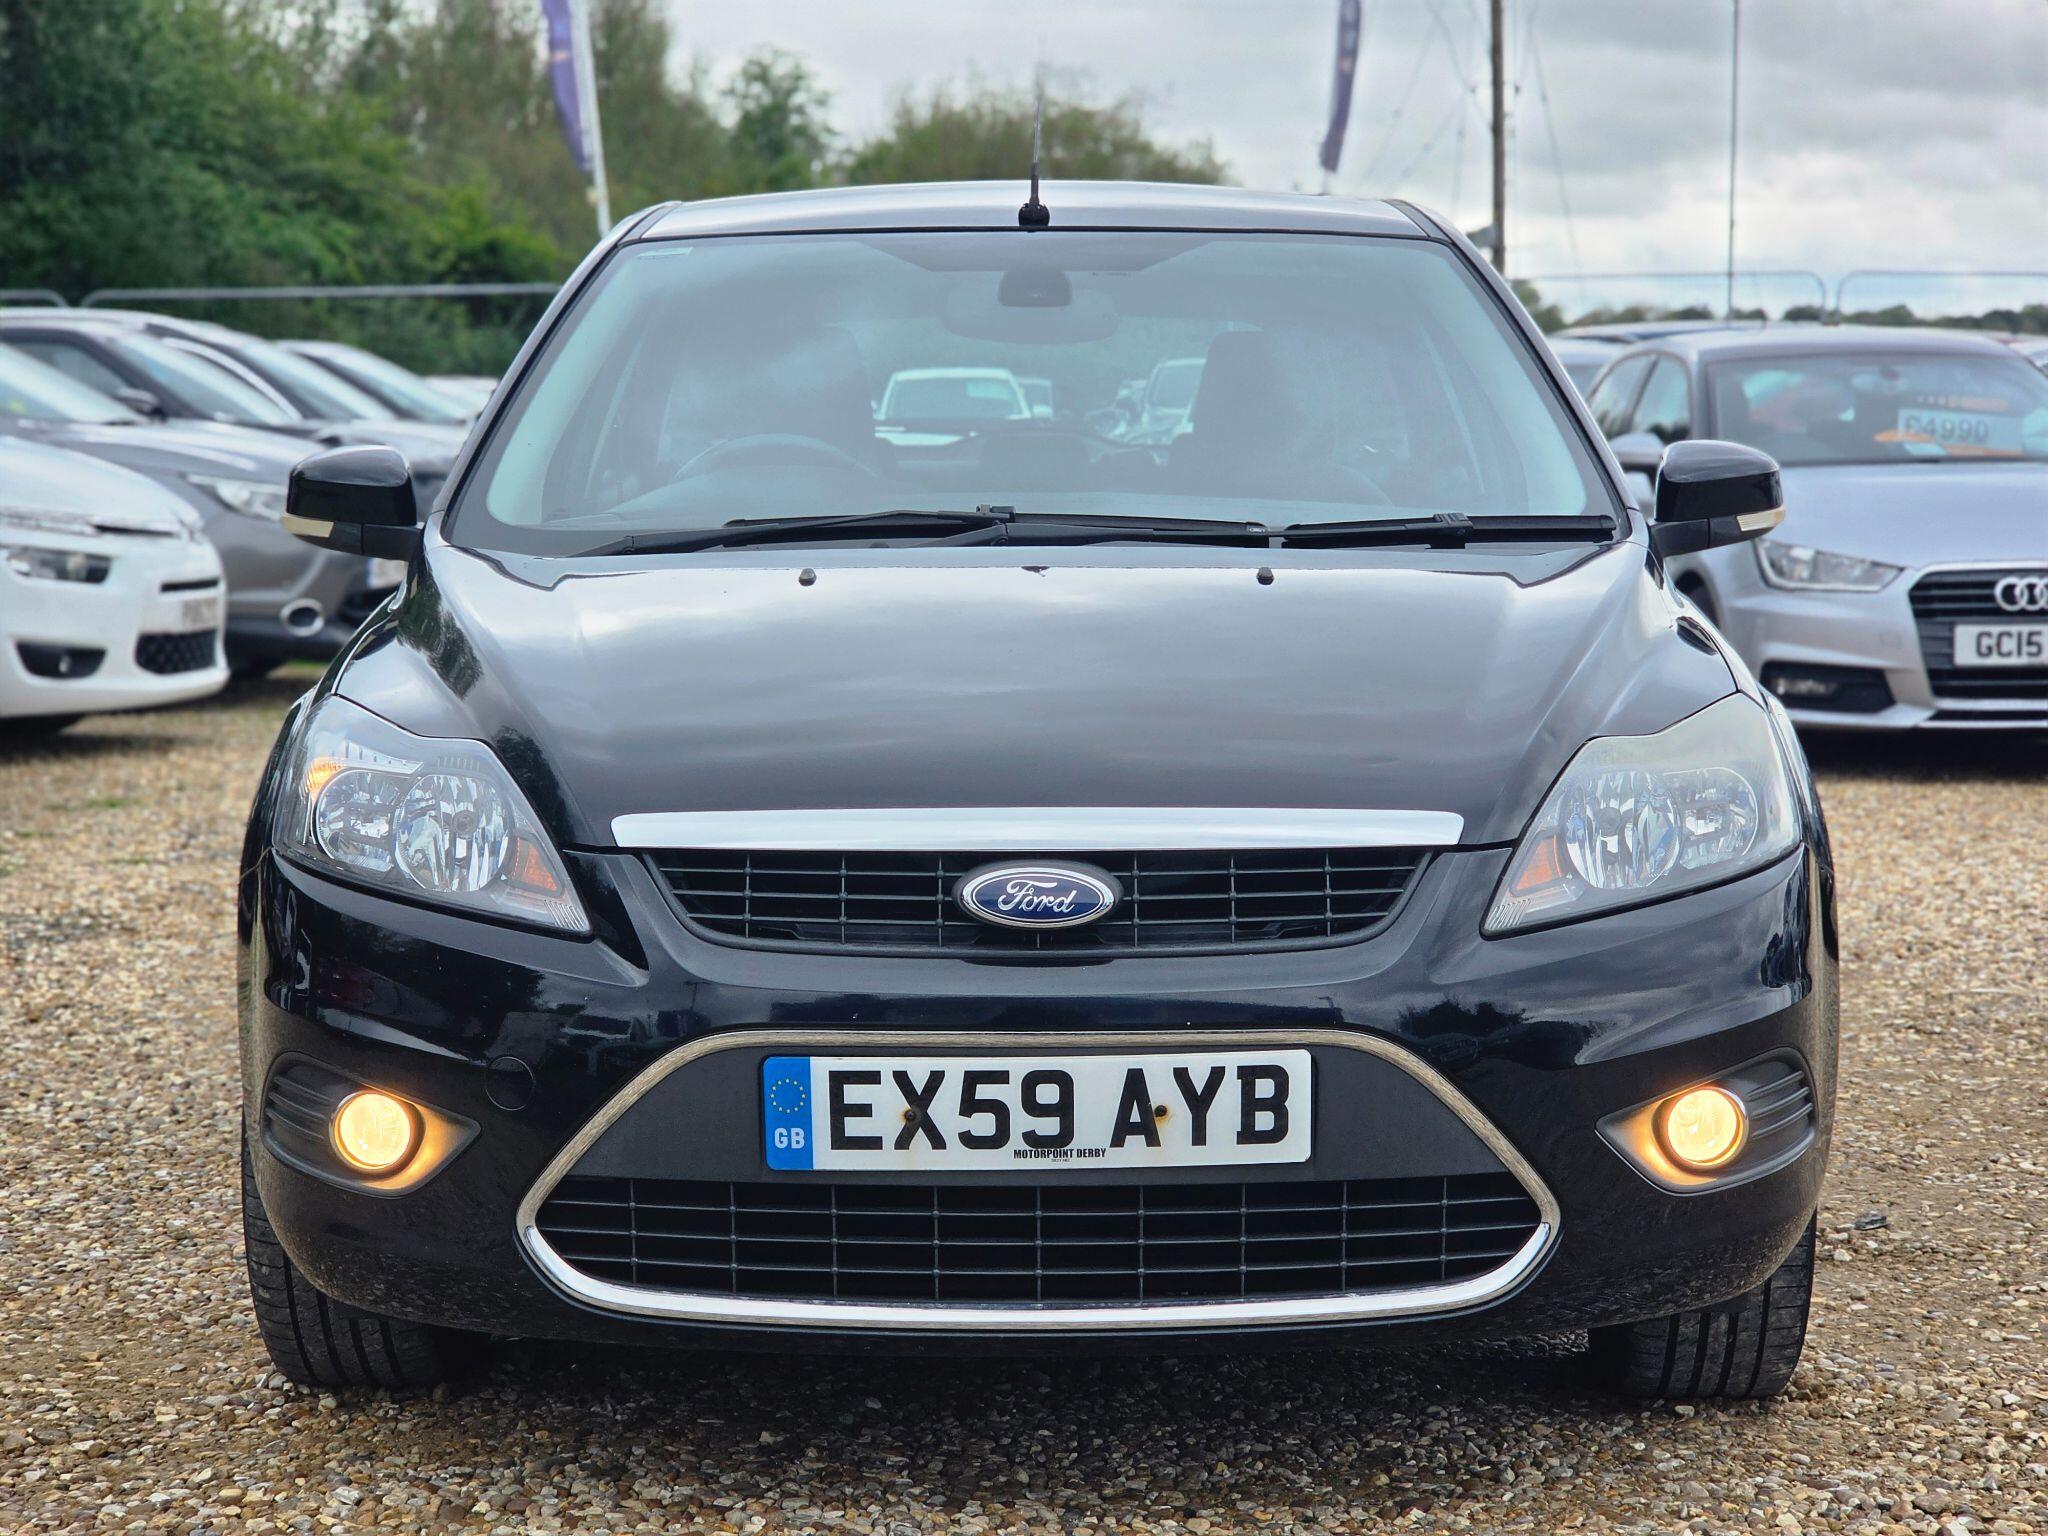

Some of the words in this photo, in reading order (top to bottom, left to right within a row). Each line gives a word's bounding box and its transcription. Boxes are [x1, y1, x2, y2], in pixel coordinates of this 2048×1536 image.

[1976, 630, 2043, 658] GC15
[997, 879, 1077, 913] Ford
[828, 1069, 1075, 1150] EX59
[1109, 1064, 1290, 1148] AYB
[774, 1127, 805, 1149] GB
[1013, 1148, 1074, 1159] MOTORPOINT
[1076, 1147, 1107, 1158] DERBY
